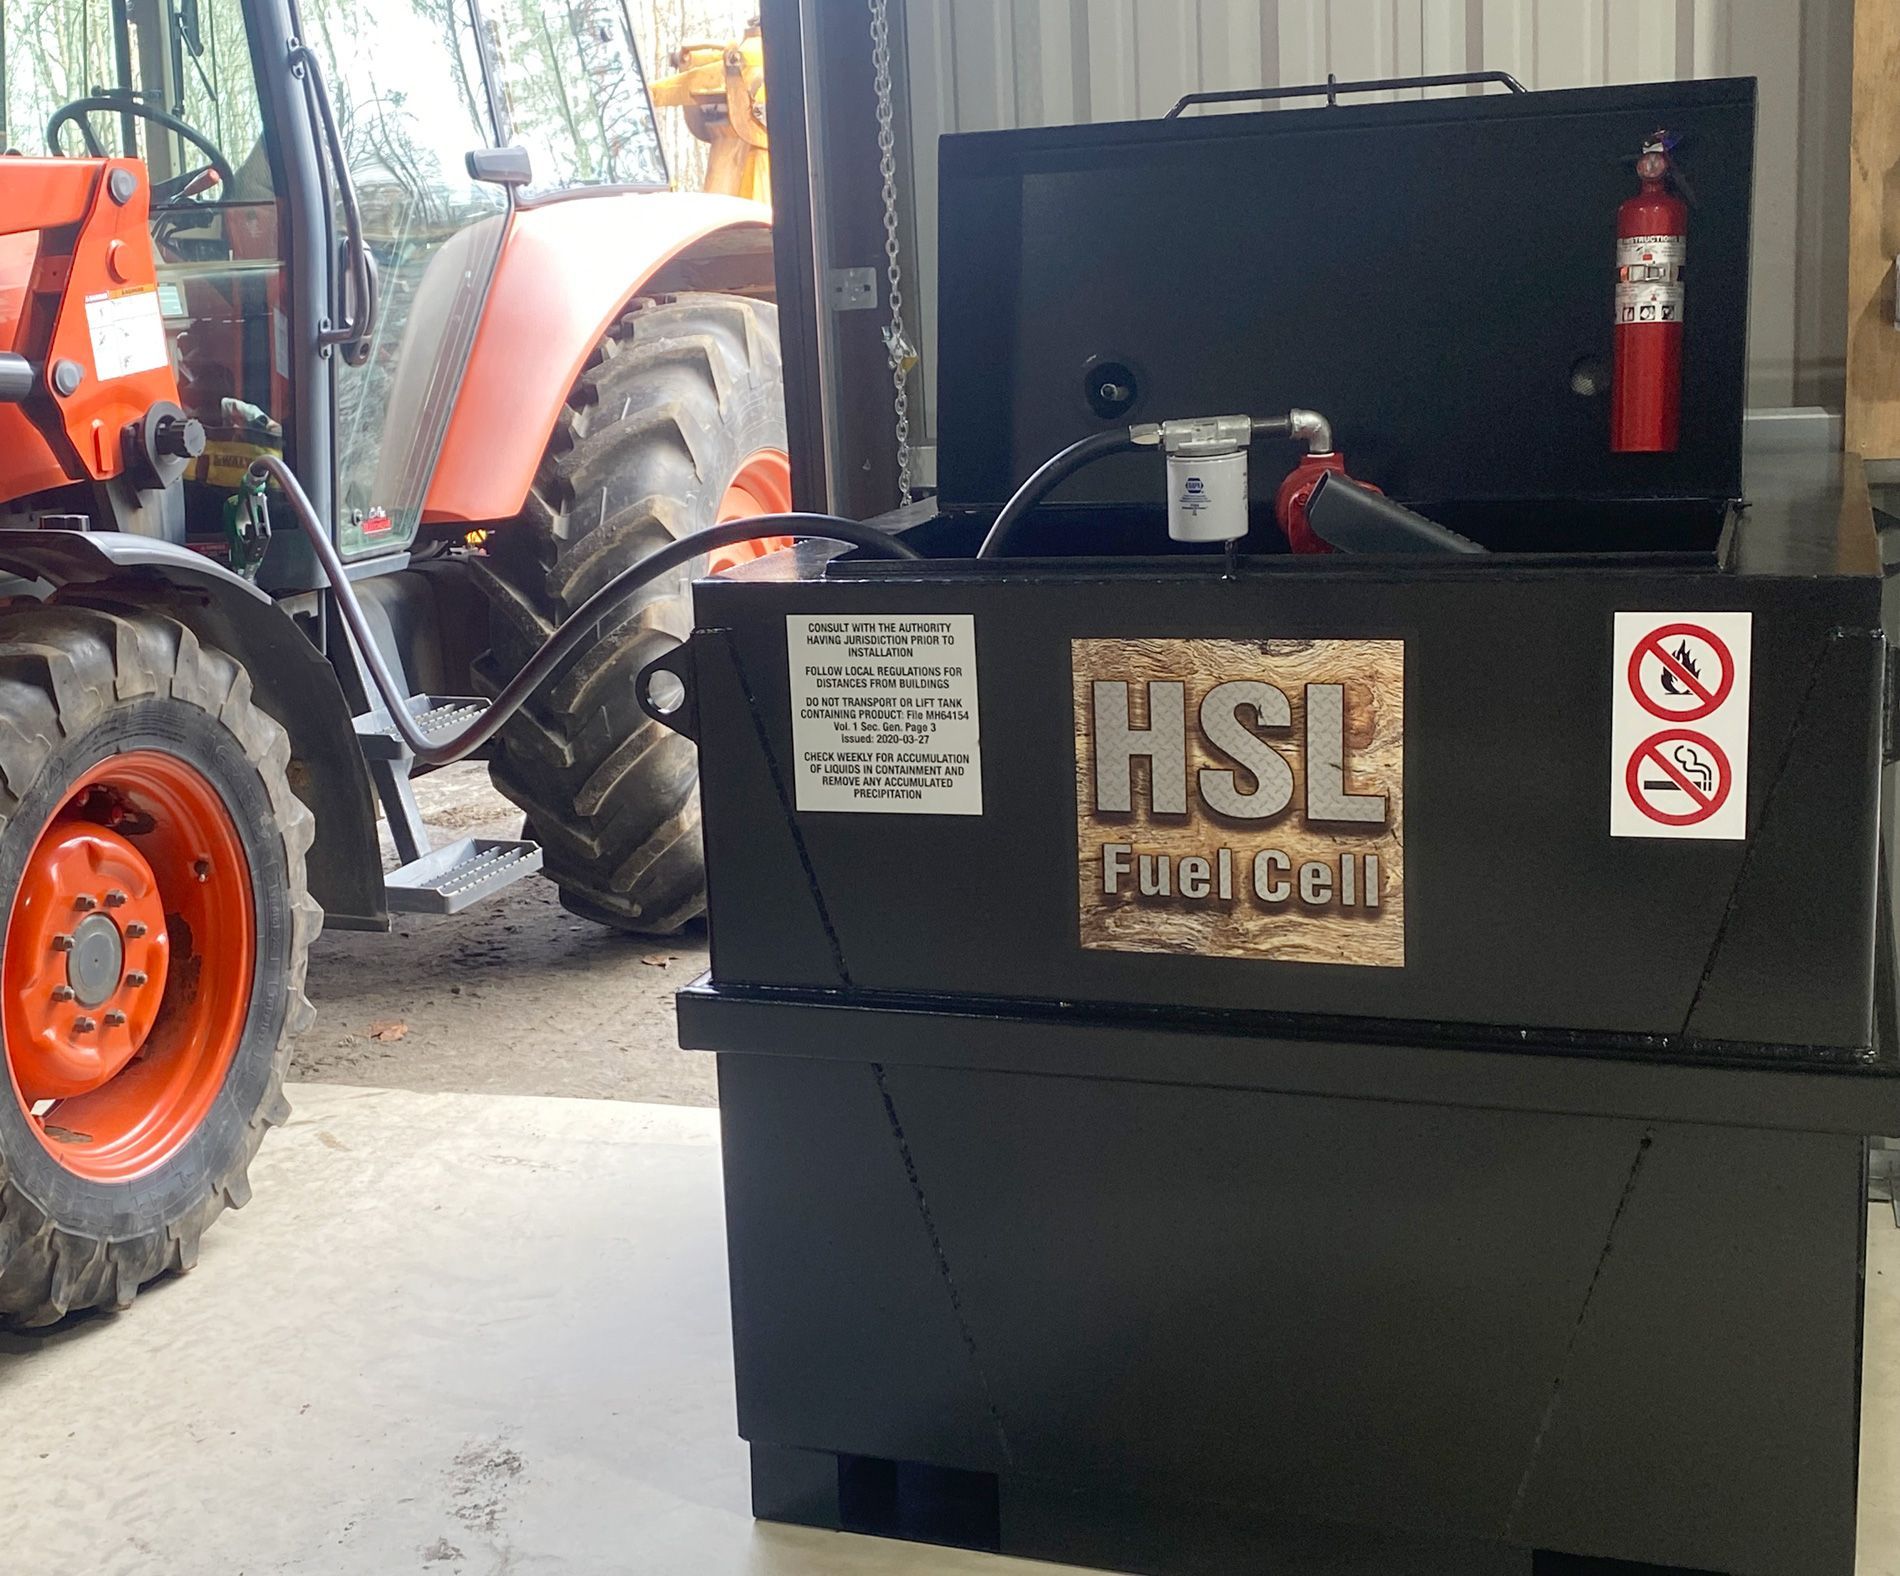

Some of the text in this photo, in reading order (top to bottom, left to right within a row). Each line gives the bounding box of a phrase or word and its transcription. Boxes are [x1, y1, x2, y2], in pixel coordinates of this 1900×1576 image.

[808, 623, 951, 632] CONSULT WITH THE AUTHORITY
[807, 635, 954, 645] HAVING JURISDICTION PRIOR TO
[848, 647, 913, 657] INSTALLATION
[805, 666, 962, 676] FOLLOW LOCAL REGULATIONS FOR
[817, 678, 949, 689] DISTANCES FROM BUILDINGS
[806, 697, 962, 708] DO NOT TRANSPORT OR LIFT TANK
[801, 709, 856, 719] CONTAINING
[907, 710, 923, 720] File
[926, 710, 969, 720] MH64154
[834, 722, 937, 735] Vol. 1 Sec. Gen. Page 3
[842, 733, 929, 744] Issued: 2020-03-27
[1093, 680, 1385, 822] HSL
[804, 752, 969, 764] CHECK WEEKLY FOR ACCUMULATION
[810, 764, 964, 776] OF LIQUIDS IN CONTAINMENT AND
[822, 776, 953, 788] REMOVE ANY ACCUMULATED
[854, 789, 921, 799] PRECIPITATION
[1102, 843, 1379, 907] Fuel Cell
